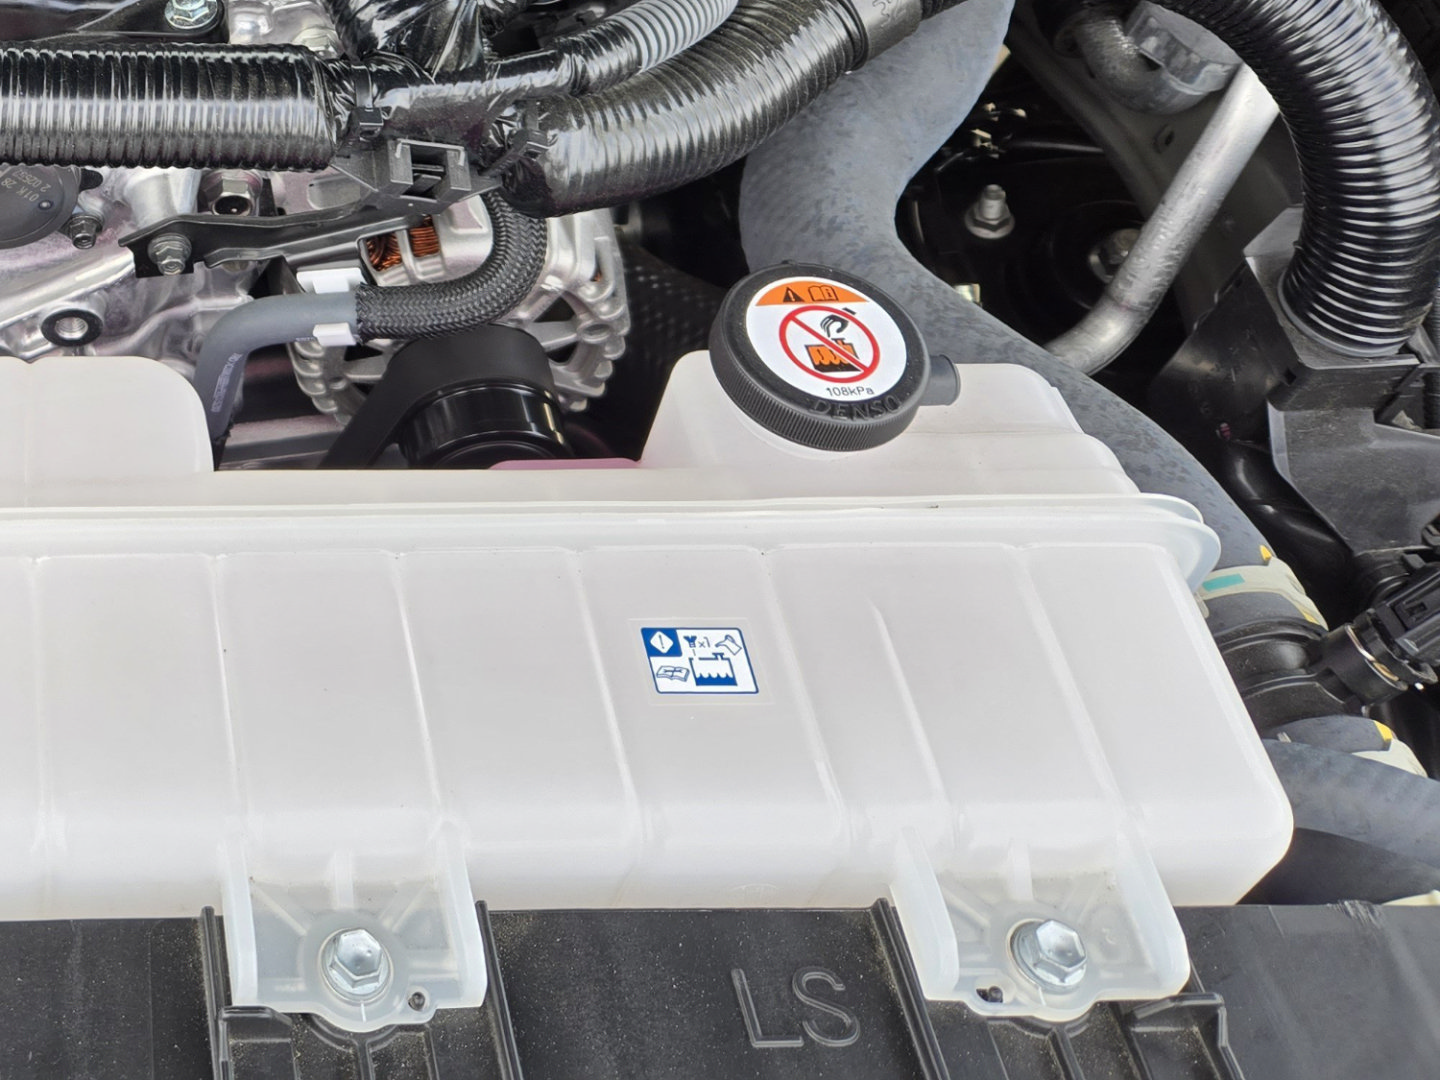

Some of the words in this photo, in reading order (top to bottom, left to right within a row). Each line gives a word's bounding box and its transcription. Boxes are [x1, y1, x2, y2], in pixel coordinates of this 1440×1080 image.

[825, 385, 875, 396] 108kPa
[808, 394, 901, 420] DENSO
[731, 968, 862, 1048] LS
